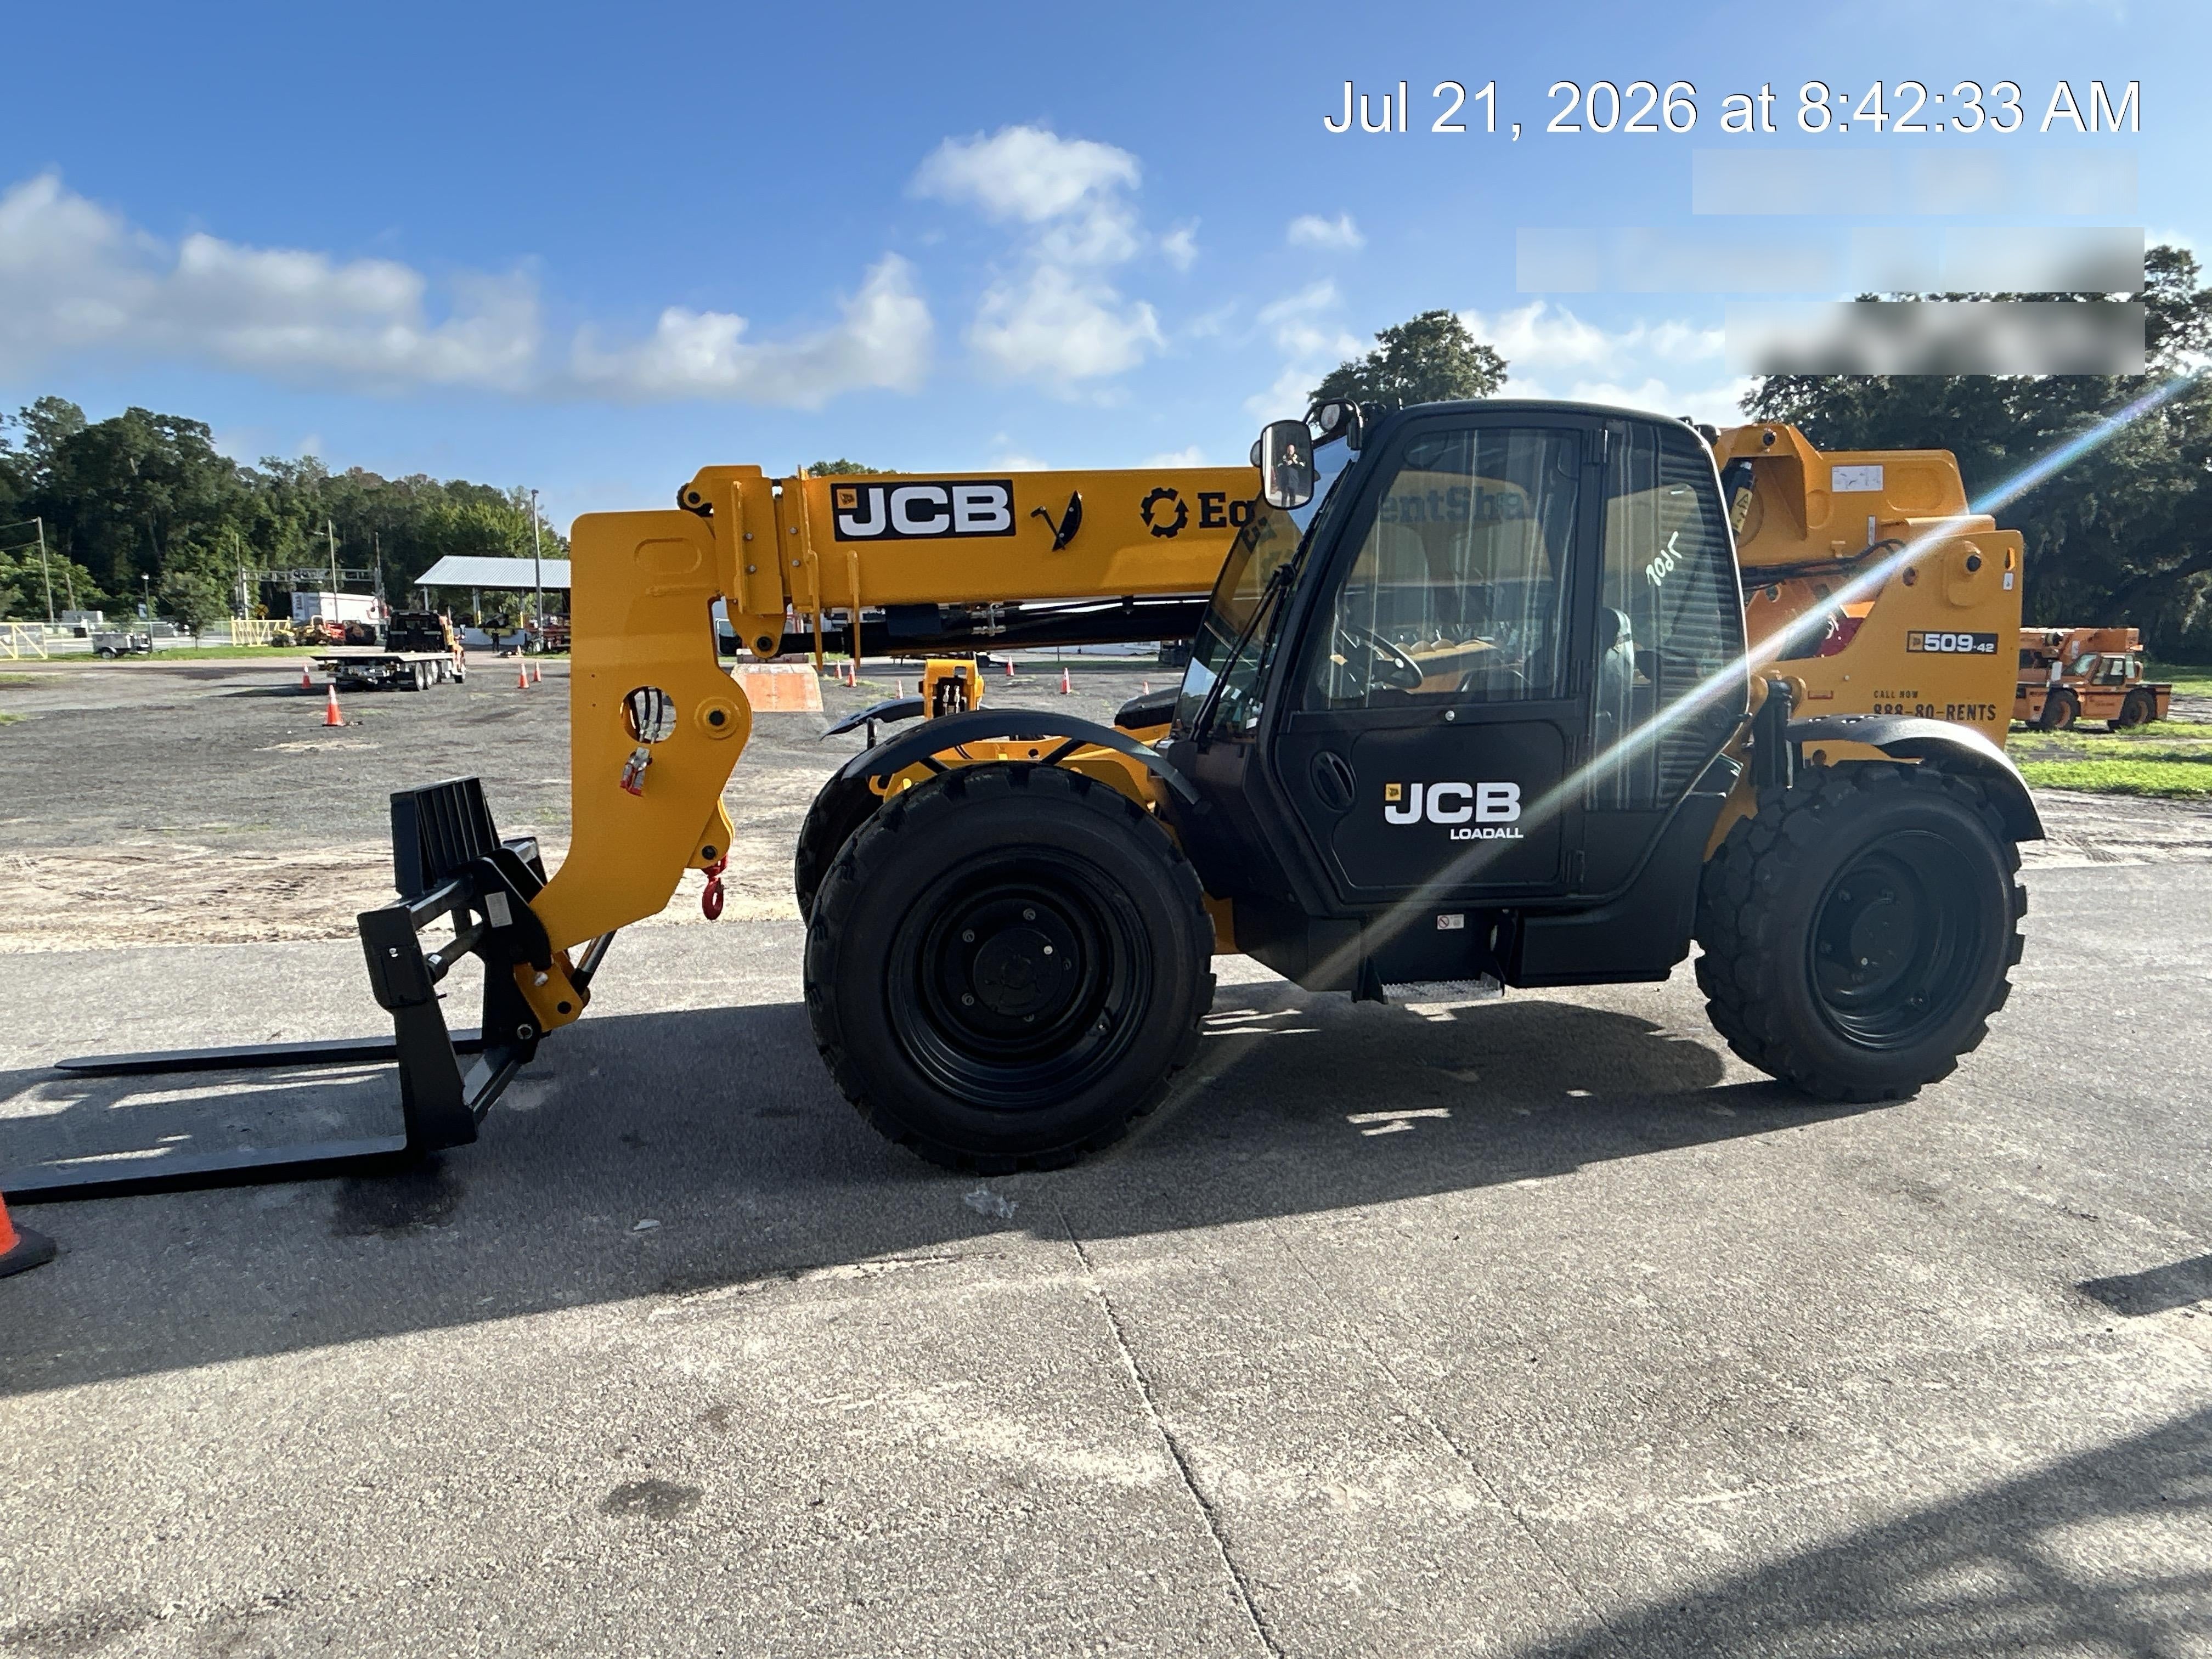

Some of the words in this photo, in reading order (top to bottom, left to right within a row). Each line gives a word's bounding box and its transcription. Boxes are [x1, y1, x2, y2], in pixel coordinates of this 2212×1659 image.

[838, 485, 1011, 536] JCB
[1923, 633, 1995, 652] 509-42
[1874, 690, 1895, 698] CALL
[1899, 690, 1918, 698] NOW
[1384, 782, 1521, 825] JCB
[1450, 827, 1524, 840] LOADALL
